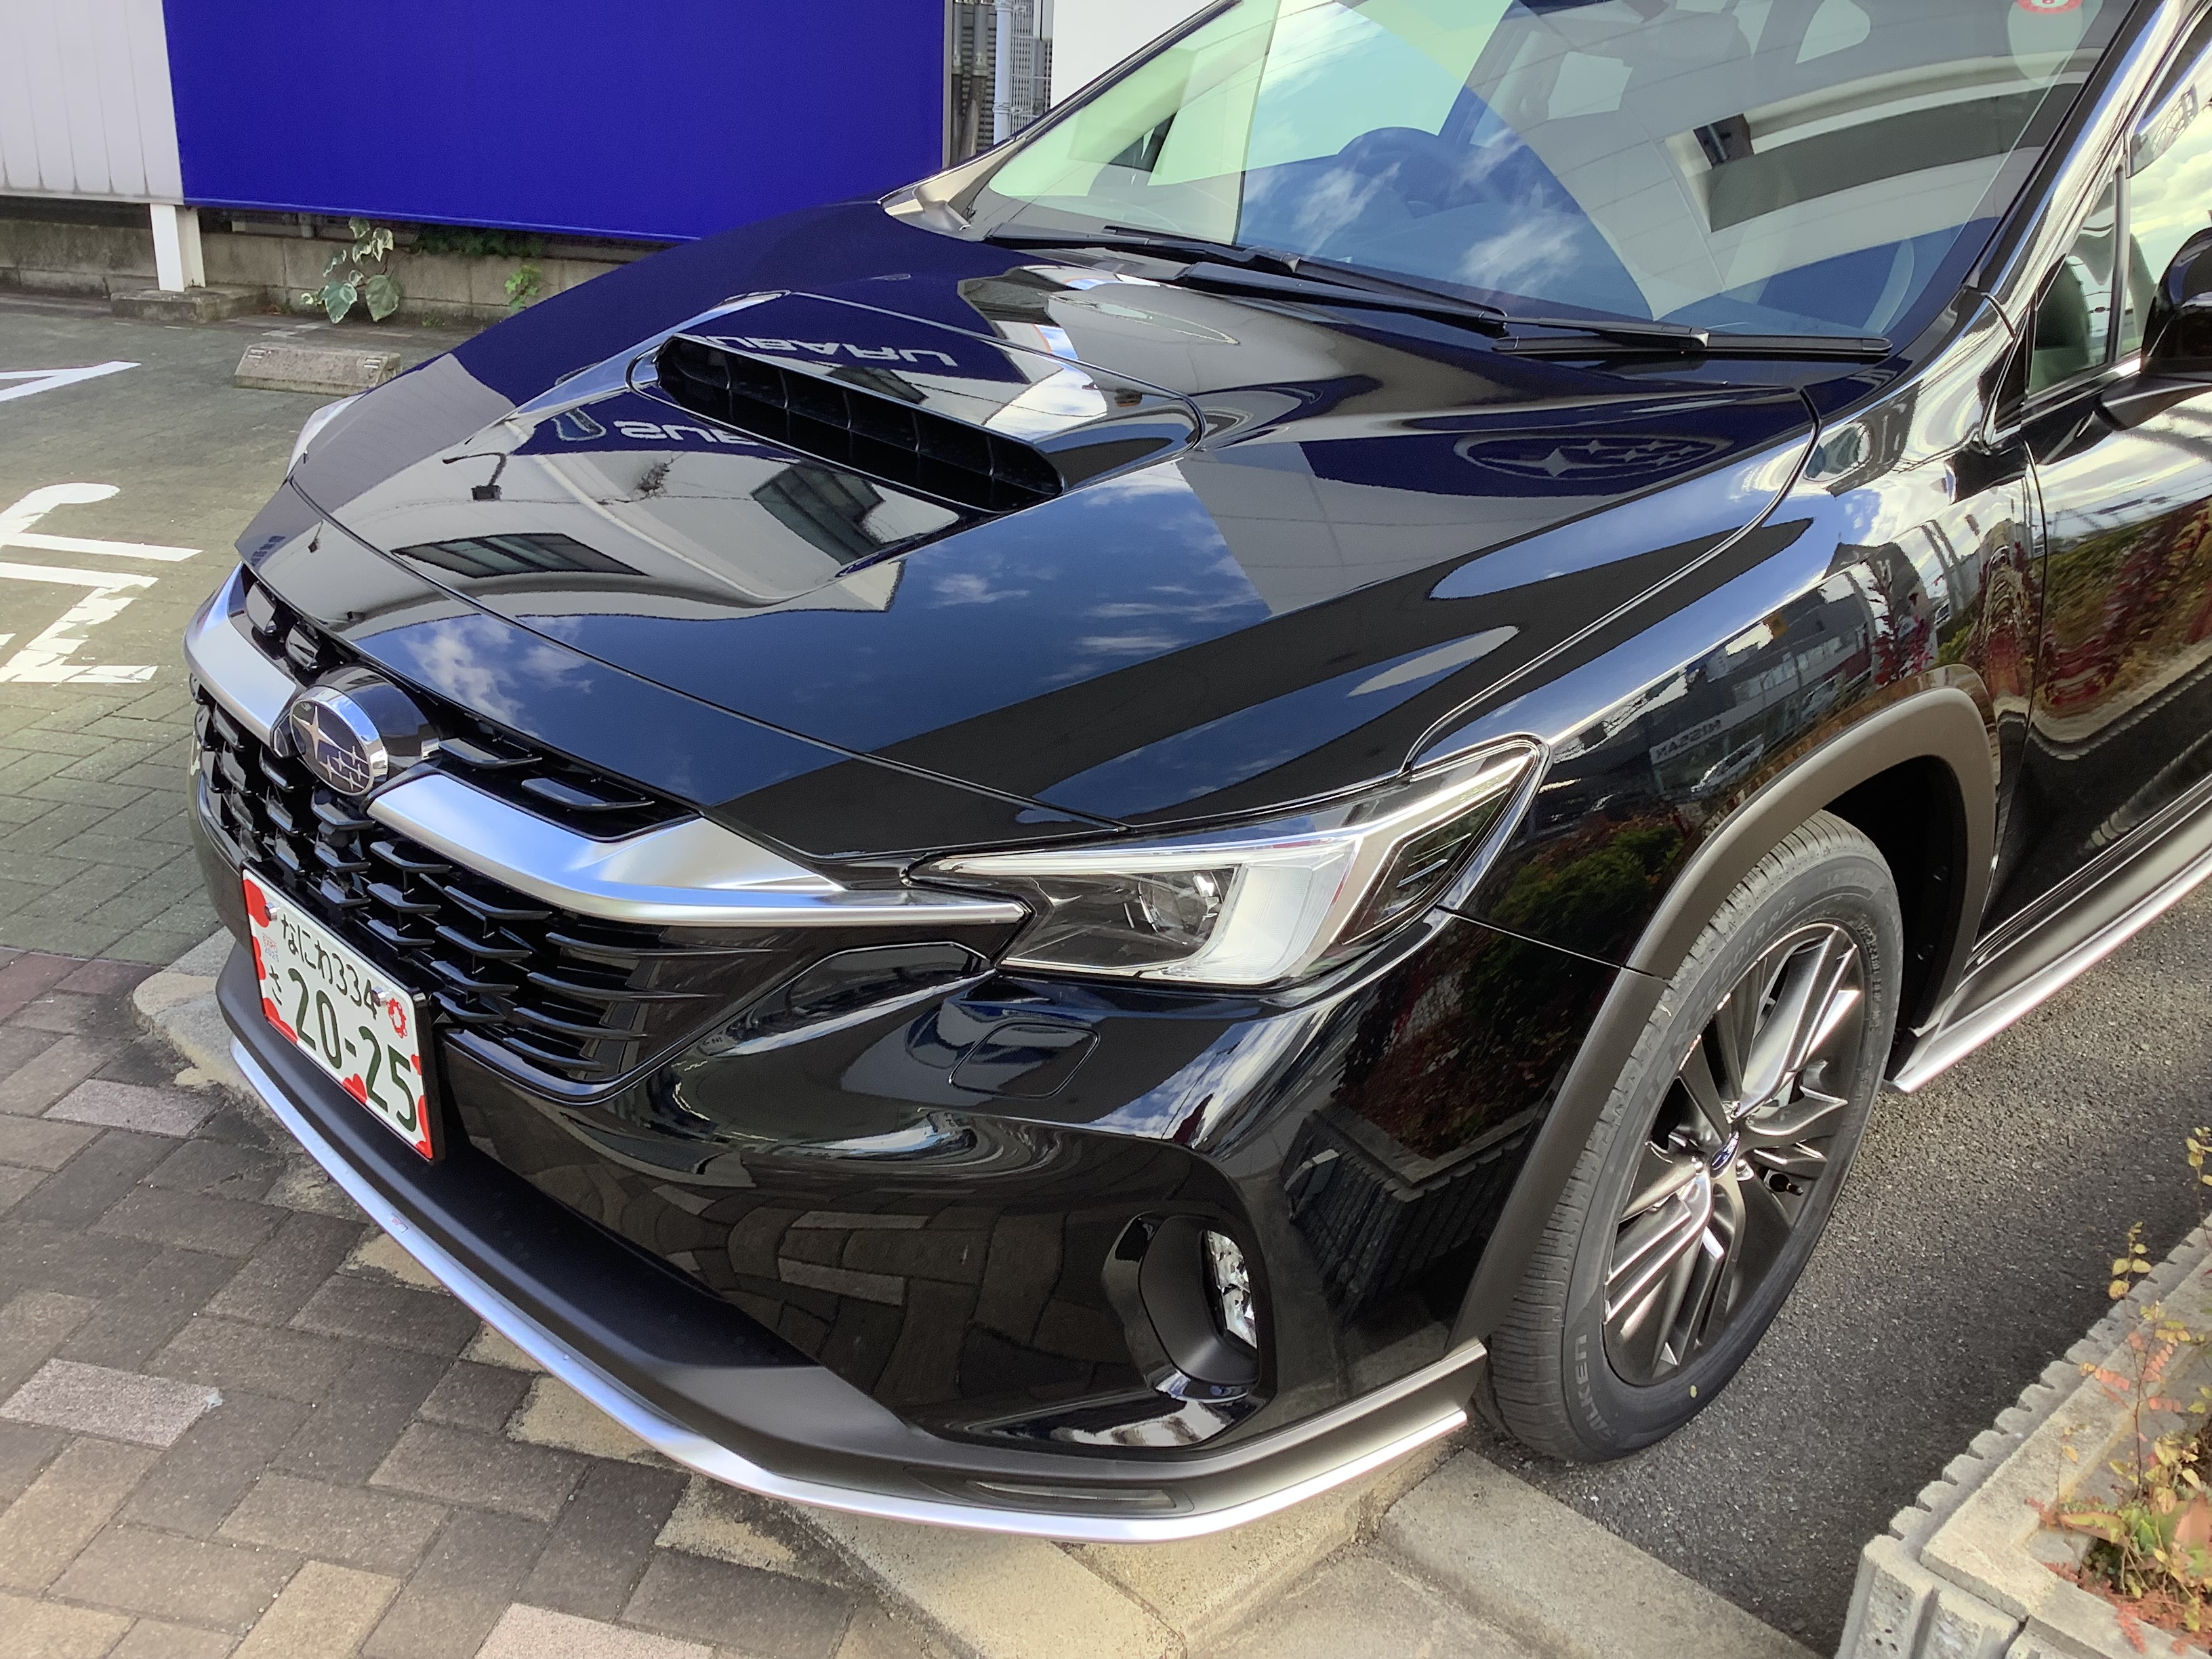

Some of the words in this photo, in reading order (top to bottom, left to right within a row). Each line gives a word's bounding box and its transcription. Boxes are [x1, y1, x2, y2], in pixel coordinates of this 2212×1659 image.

[262, 933, 278, 954] EXPO
[264, 945, 280, 963] 2025
[268, 964, 283, 1006] さ
[288, 967, 417, 1132] 20-25
